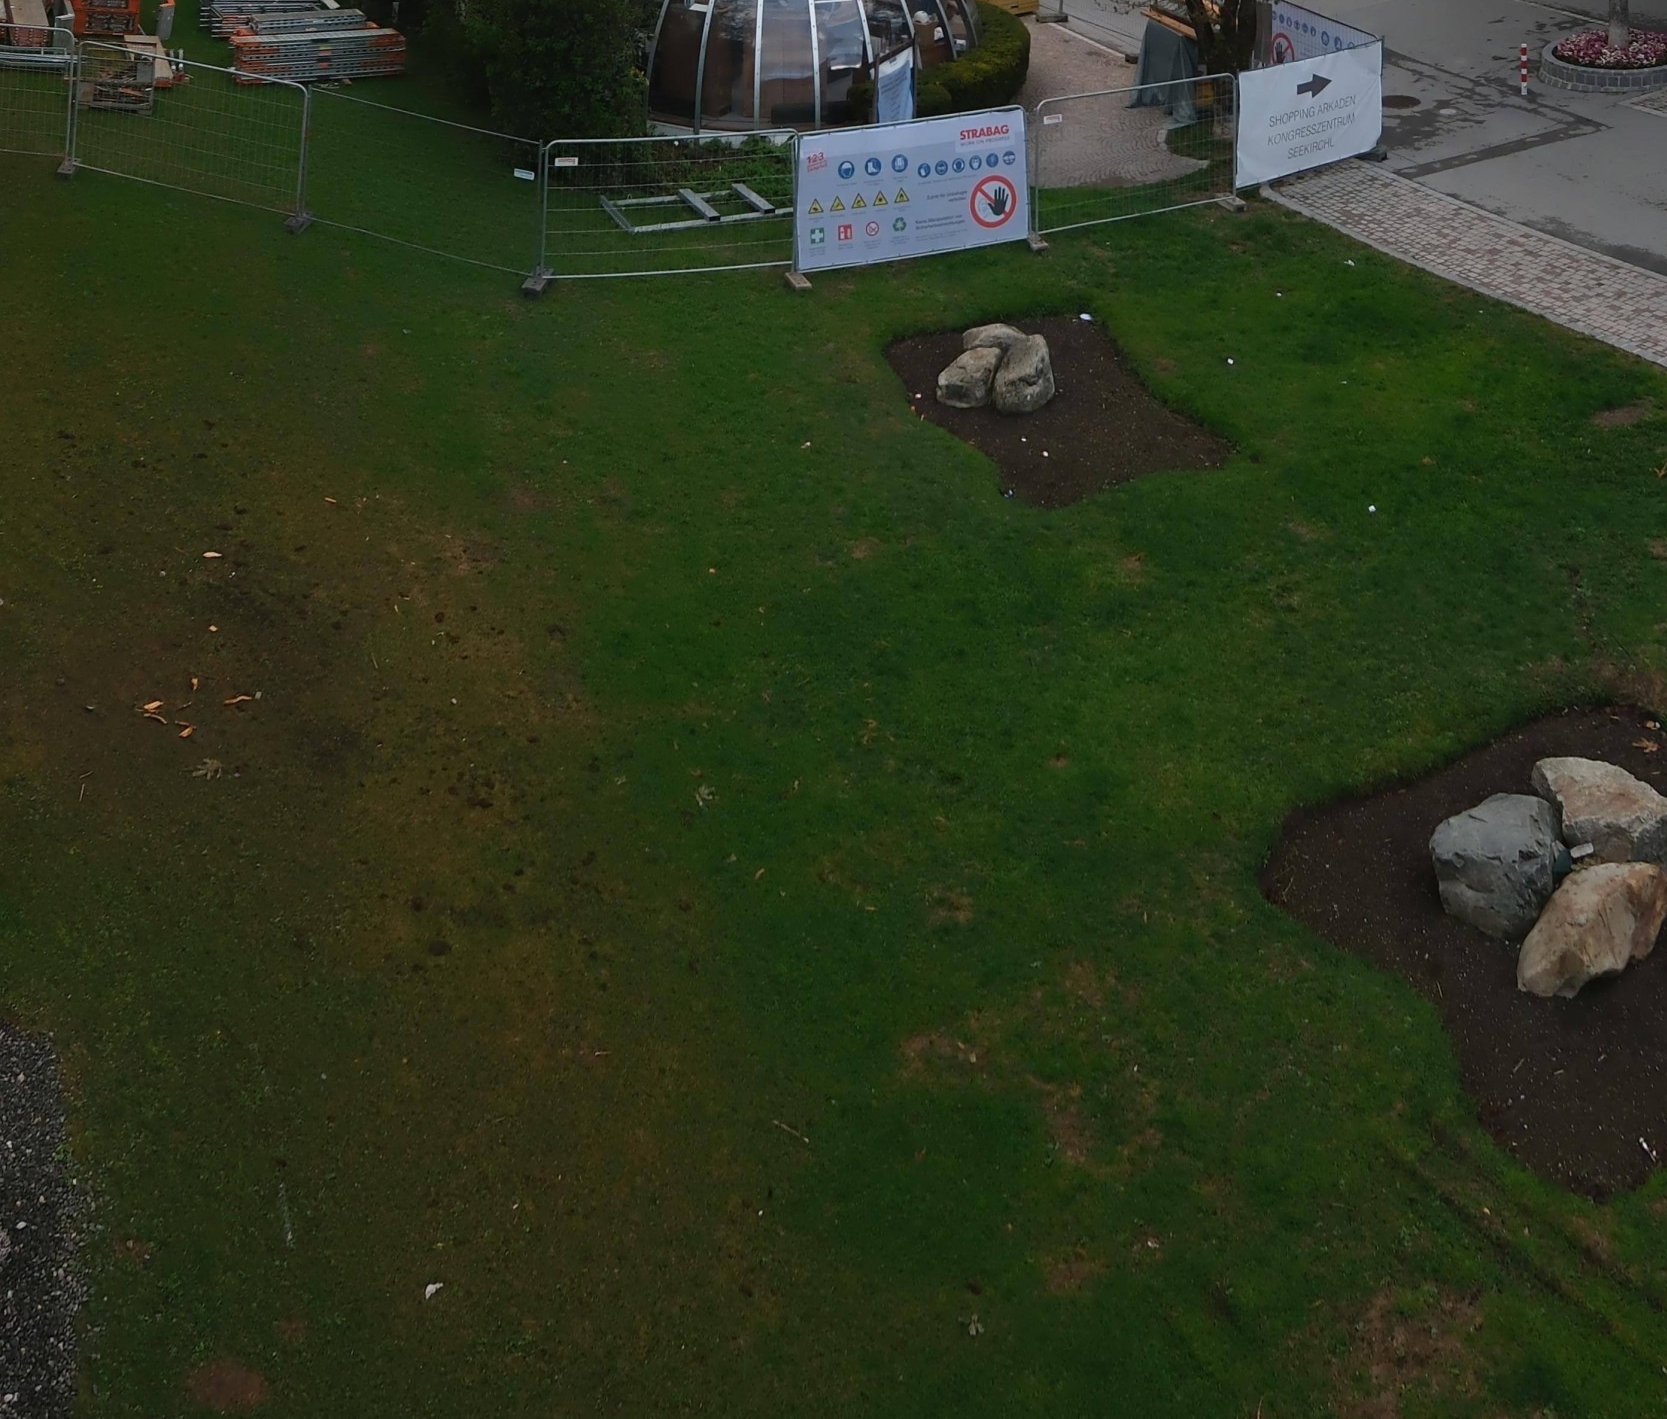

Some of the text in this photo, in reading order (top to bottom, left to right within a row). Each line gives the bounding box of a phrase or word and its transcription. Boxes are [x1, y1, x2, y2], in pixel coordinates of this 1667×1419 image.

[1268, 94, 1356, 128] SHOPPING ARKADEN
[960, 124, 1009, 140] STRABAG
[1267, 113, 1356, 146] KONGRESSZENTRUM
[1287, 137, 1335, 160] SEEKIRCHL
